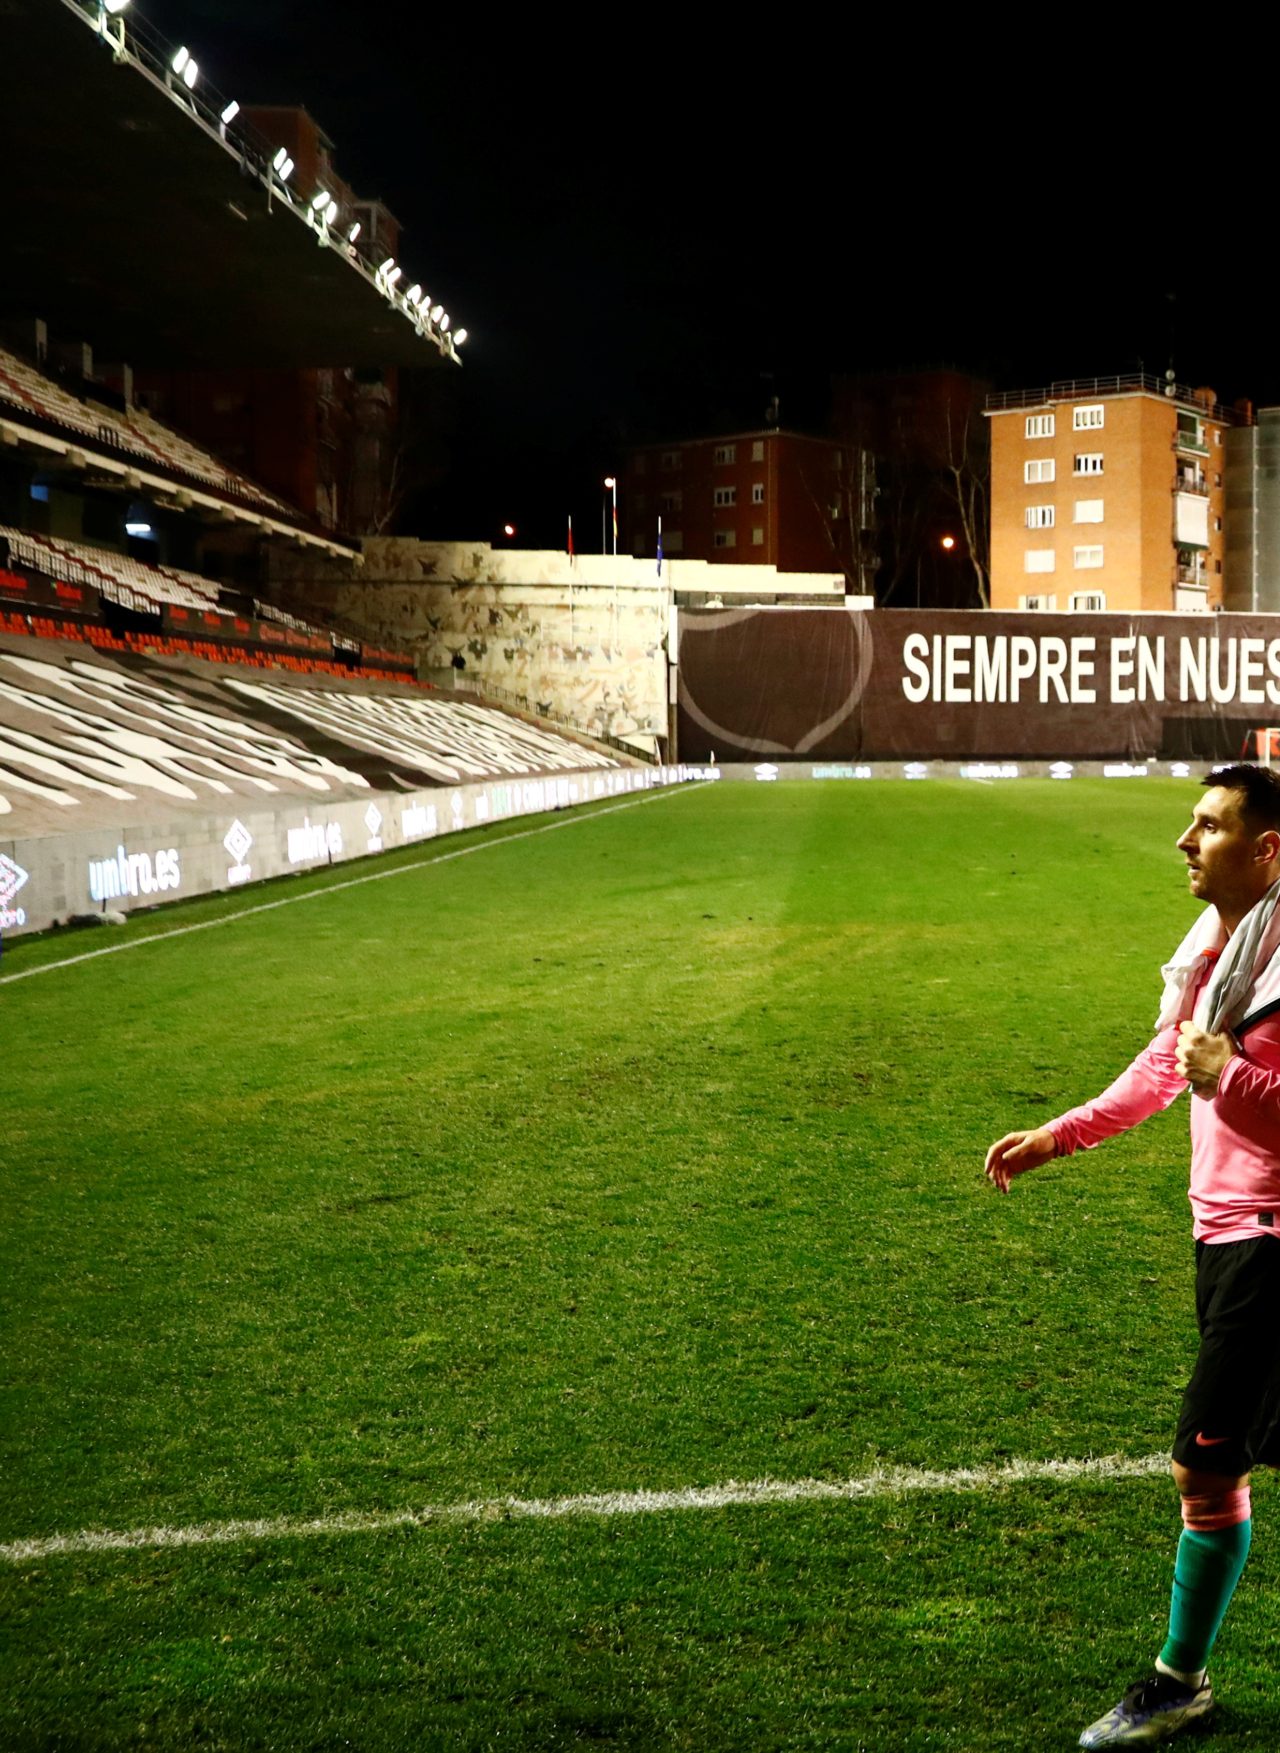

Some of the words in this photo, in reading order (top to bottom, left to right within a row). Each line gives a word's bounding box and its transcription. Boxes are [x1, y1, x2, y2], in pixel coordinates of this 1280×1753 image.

[901, 633, 1096, 704] SIEMPRE
[1110, 635, 1165, 704] EN
[88, 845, 181, 901] umbro.es
